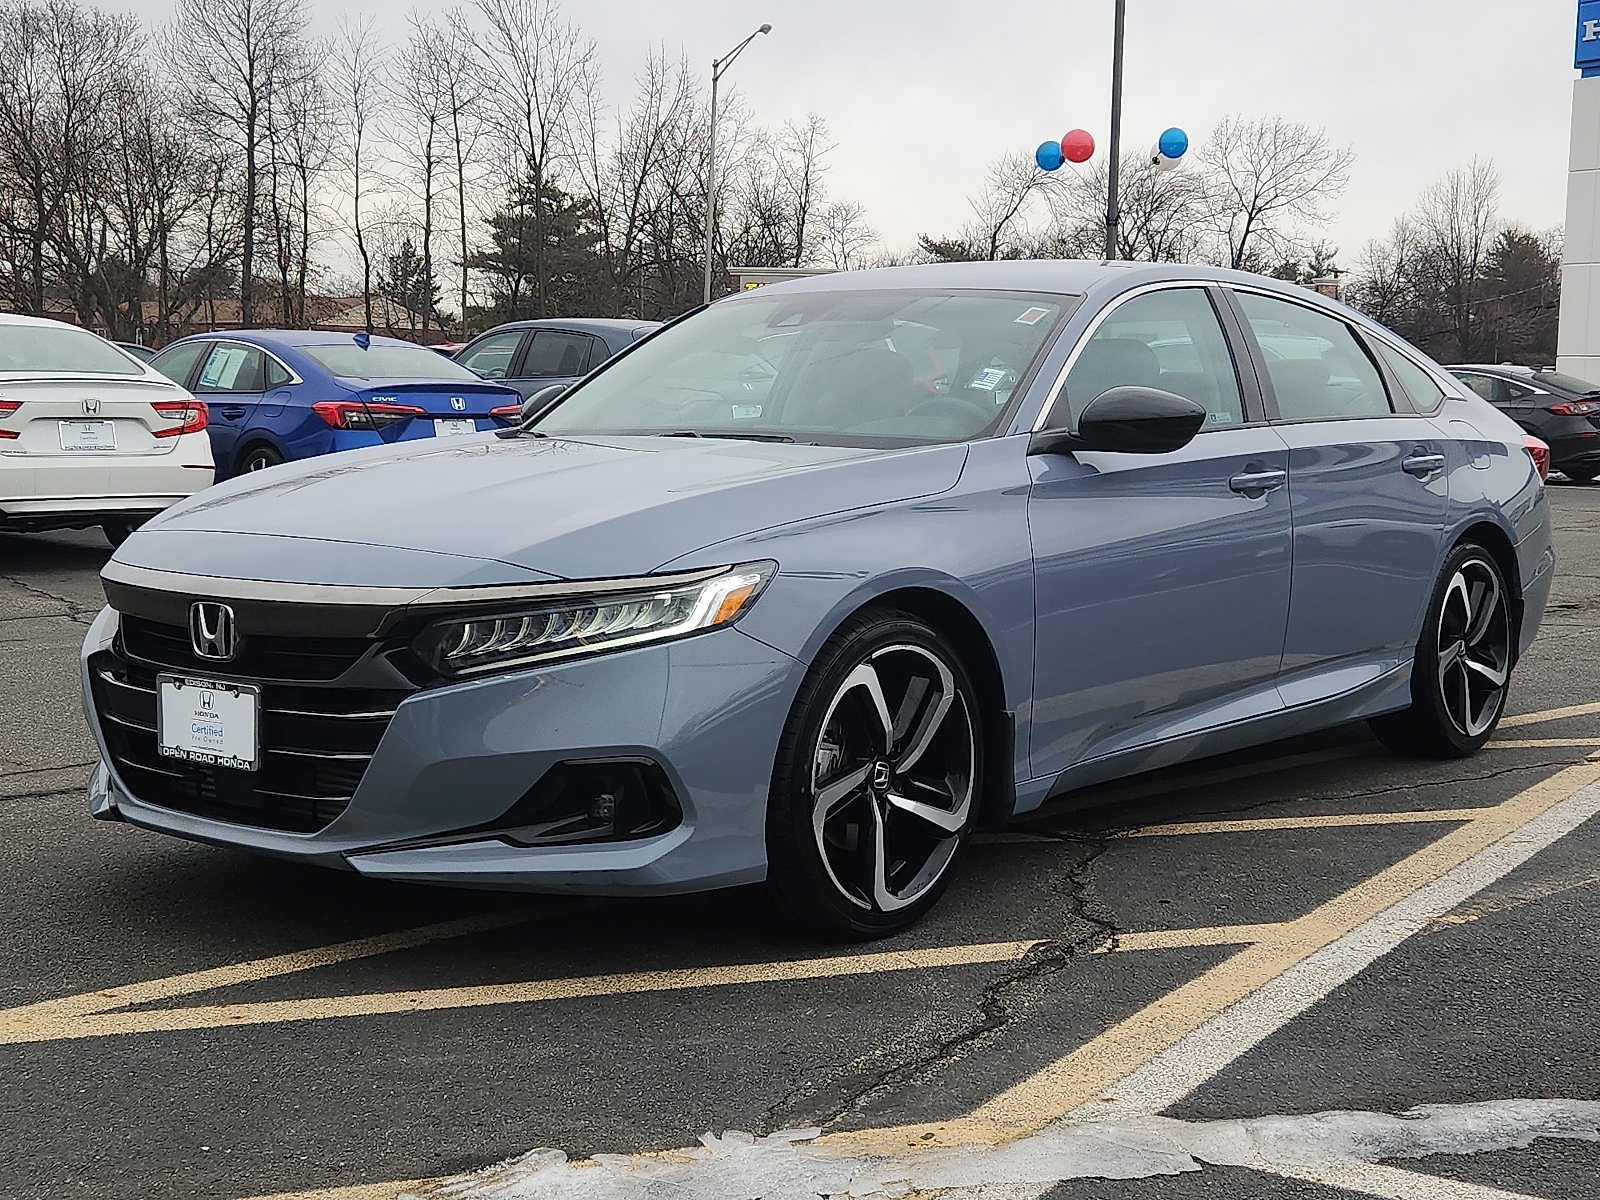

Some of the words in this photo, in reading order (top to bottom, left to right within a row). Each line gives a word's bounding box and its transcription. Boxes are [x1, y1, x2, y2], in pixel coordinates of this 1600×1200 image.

[194, 710, 219, 719] HONDA
[191, 723, 223, 737] Certified
[163, 747, 187, 759] OPEN
[189, 752, 215, 764] ROAD
[217, 756, 250, 770] HONDA
